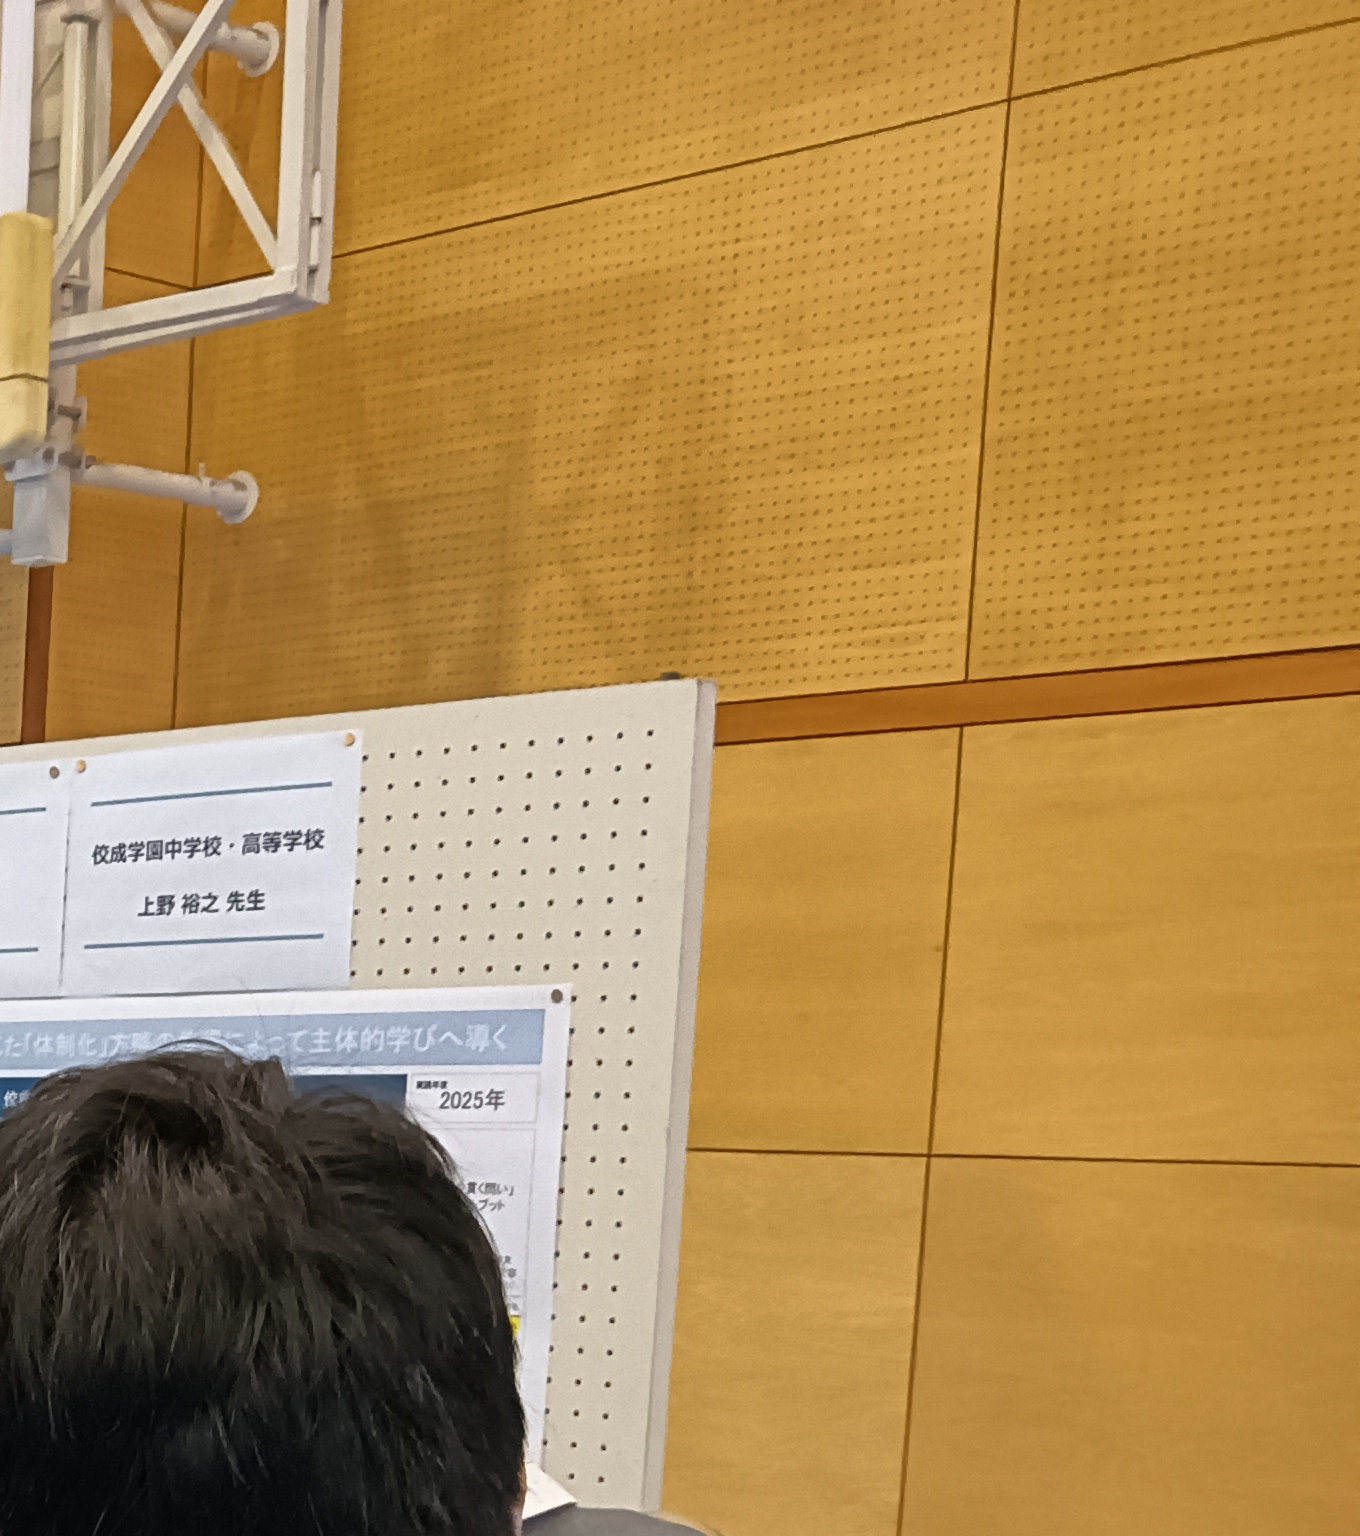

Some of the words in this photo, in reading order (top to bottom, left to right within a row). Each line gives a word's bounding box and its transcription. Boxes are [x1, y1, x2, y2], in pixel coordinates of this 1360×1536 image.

[92, 828, 325, 865] 佼成学園中学校・高等学校
[137, 895, 176, 917] 上野
[180, 892, 220, 915] 裕之
[225, 889, 265, 912] 先生
[439, 1088, 506, 1111] 2025年
